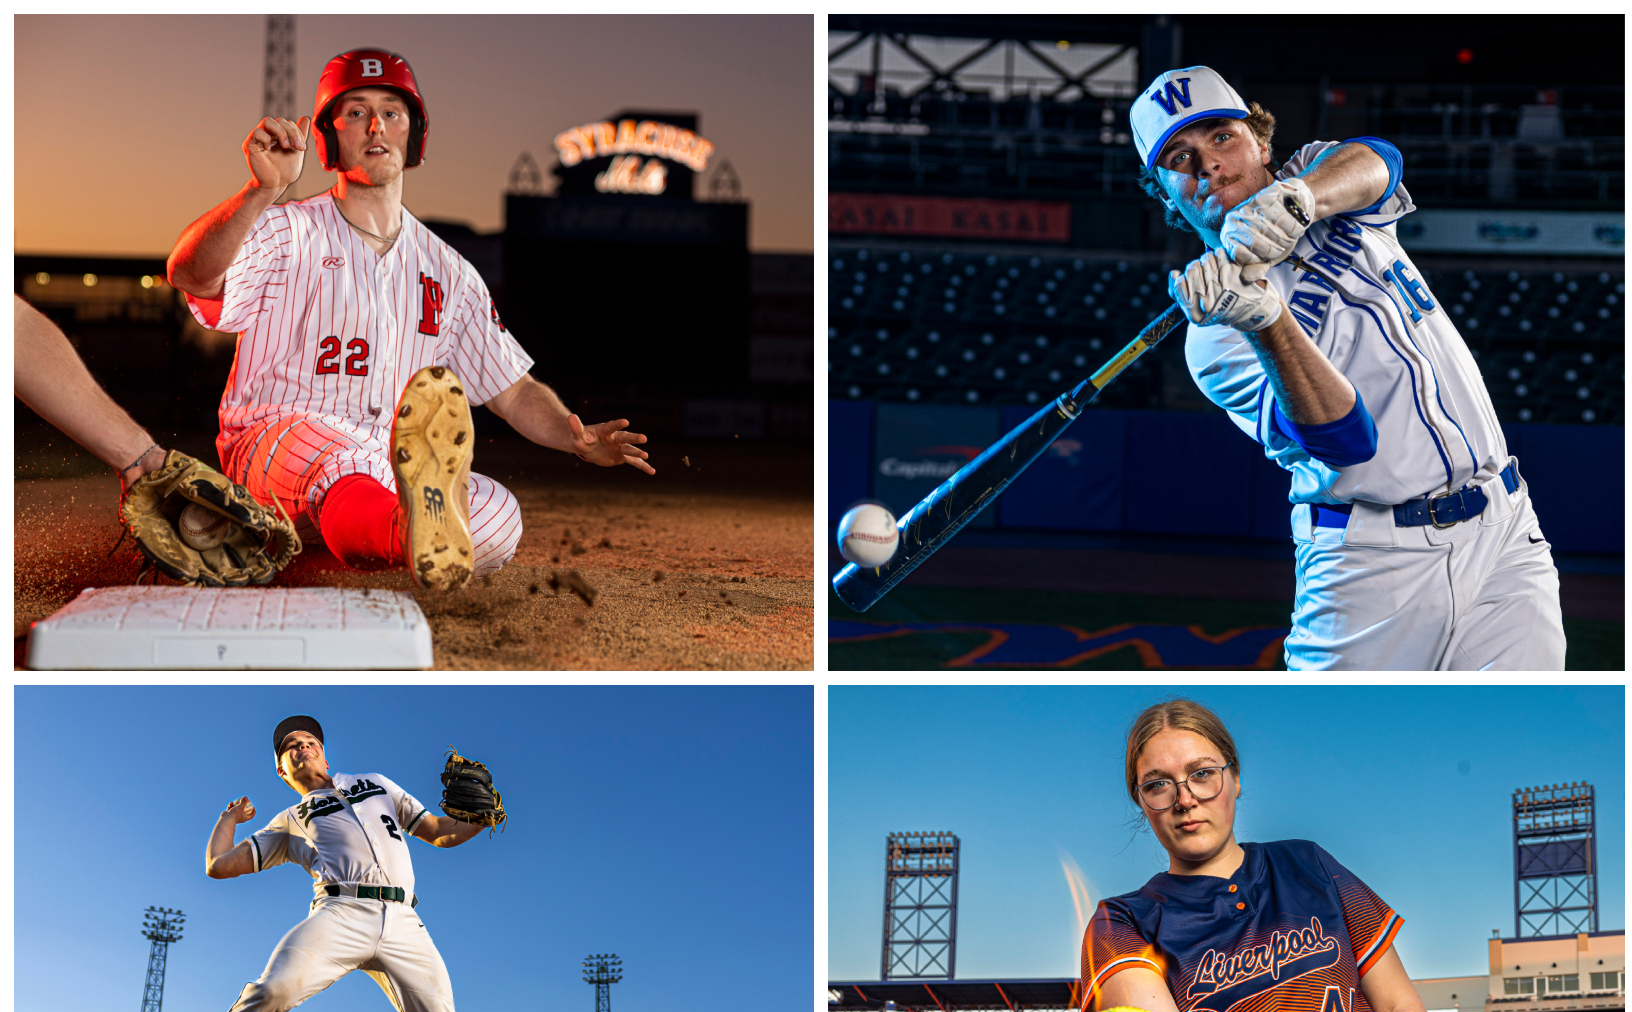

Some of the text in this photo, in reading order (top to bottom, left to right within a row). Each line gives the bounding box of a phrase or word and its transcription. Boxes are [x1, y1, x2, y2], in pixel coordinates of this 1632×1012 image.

[360, 58, 384, 77] B
[1150, 77, 1192, 117] W
[554, 119, 715, 172] SYRACUSE
[828, 205, 915, 230] ASAI
[1379, 257, 1438, 330] 16
[315, 336, 370, 377] 22
[380, 813, 403, 842] 2
[1186, 916, 1332, 1000] Liverpool
